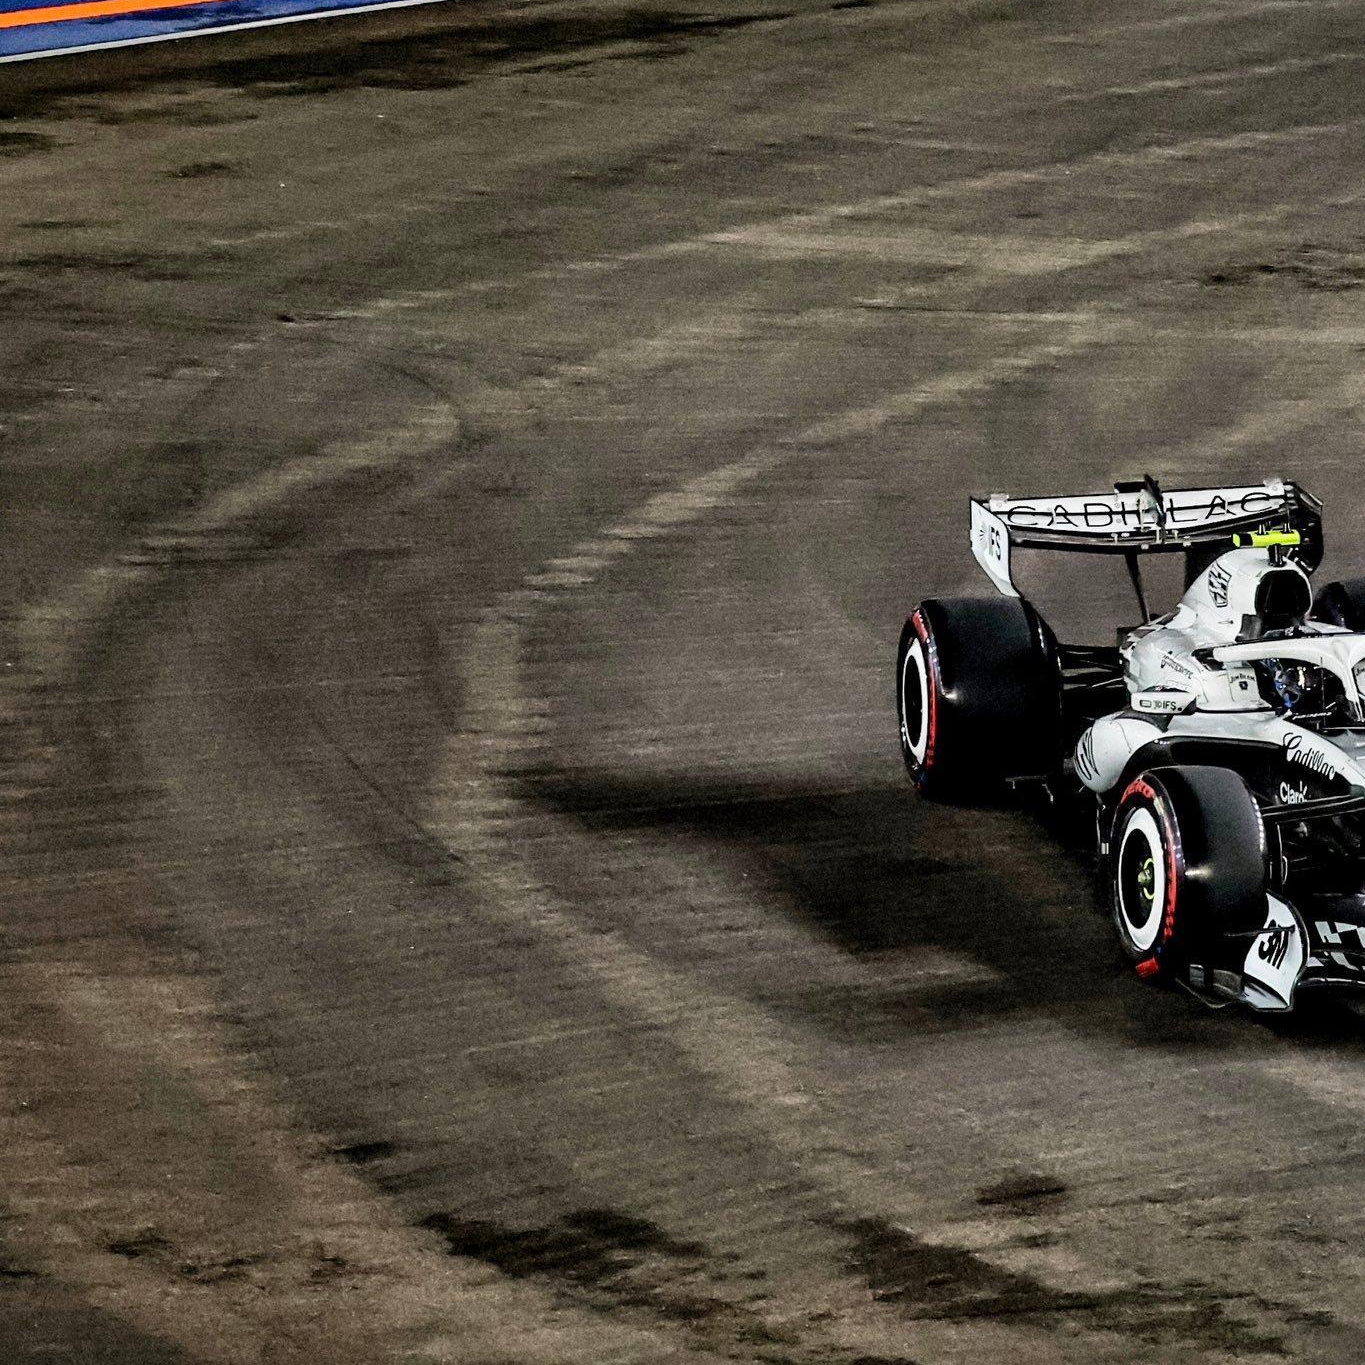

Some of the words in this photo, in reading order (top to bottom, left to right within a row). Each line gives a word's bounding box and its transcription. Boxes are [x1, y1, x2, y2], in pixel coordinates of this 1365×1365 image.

[1007, 492, 1273, 528] CADILLAC
[1163, 700, 1177, 711] IFS
[1283, 732, 1337, 780] Cadillac
